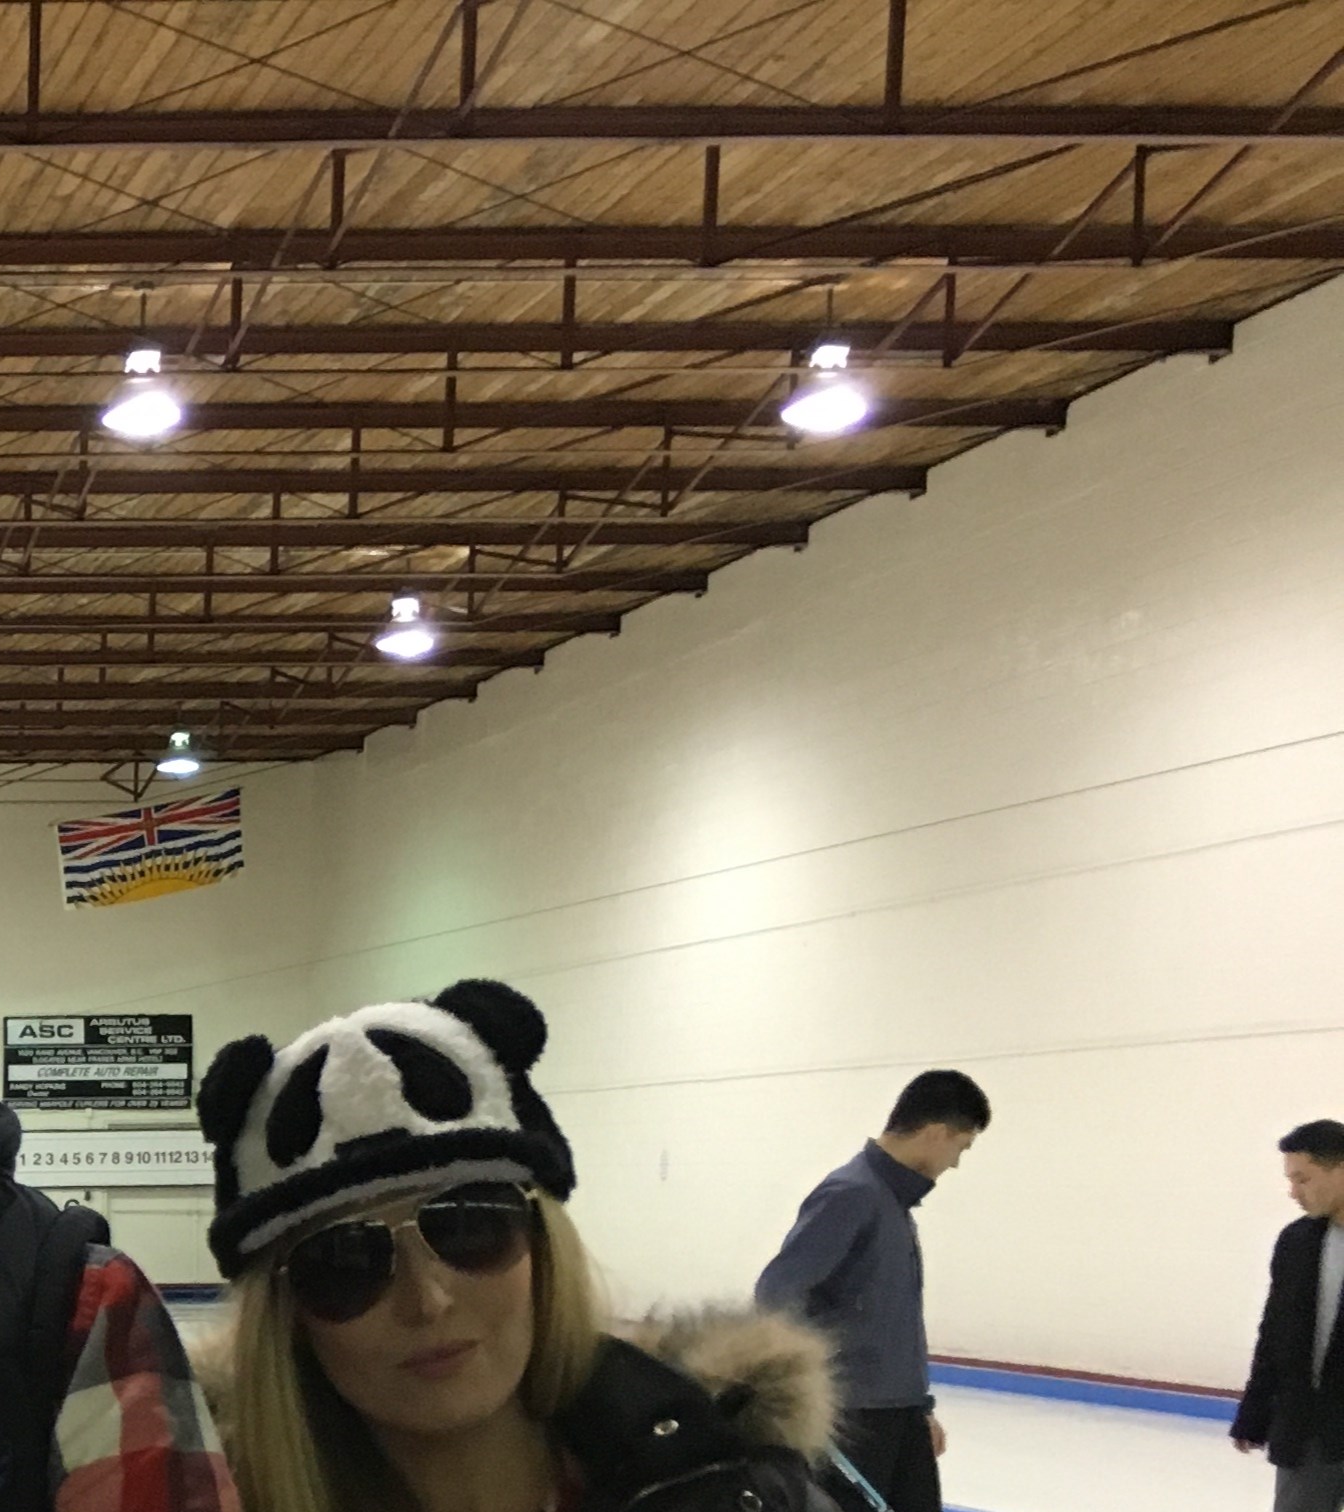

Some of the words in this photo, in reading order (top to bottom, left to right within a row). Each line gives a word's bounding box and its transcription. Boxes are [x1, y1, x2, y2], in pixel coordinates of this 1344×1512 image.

[89, 1018, 150, 1027] ARBUTUS
[18, 1024, 74, 1038] ASC
[99, 1026, 152, 1036] SERVICE
[107, 1035, 157, 1044] CENTRE
[160, 1035, 186, 1044] LTD.
[37, 1066, 90, 1078] COMPLETE
[94, 1067, 121, 1077] AUTO
[123, 1066, 159, 1077] REPAIR
[33, 1153, 42, 1166] 2
[45, 1153, 55, 1166] 3
[59, 1153, 68, 1166] 4
[72, 1152, 81, 1165] 5
[85, 1152, 95, 1165] 6
[99, 1152, 108, 1165] 7
[111, 1152, 121, 1165] 8
[125, 1151, 134, 1164] 9
[137, 1151, 151, 1164] 10
[155, 1151, 167, 1163] 11
[168, 1151, 182, 1163] 12
[184, 1150, 199, 1163] 13
